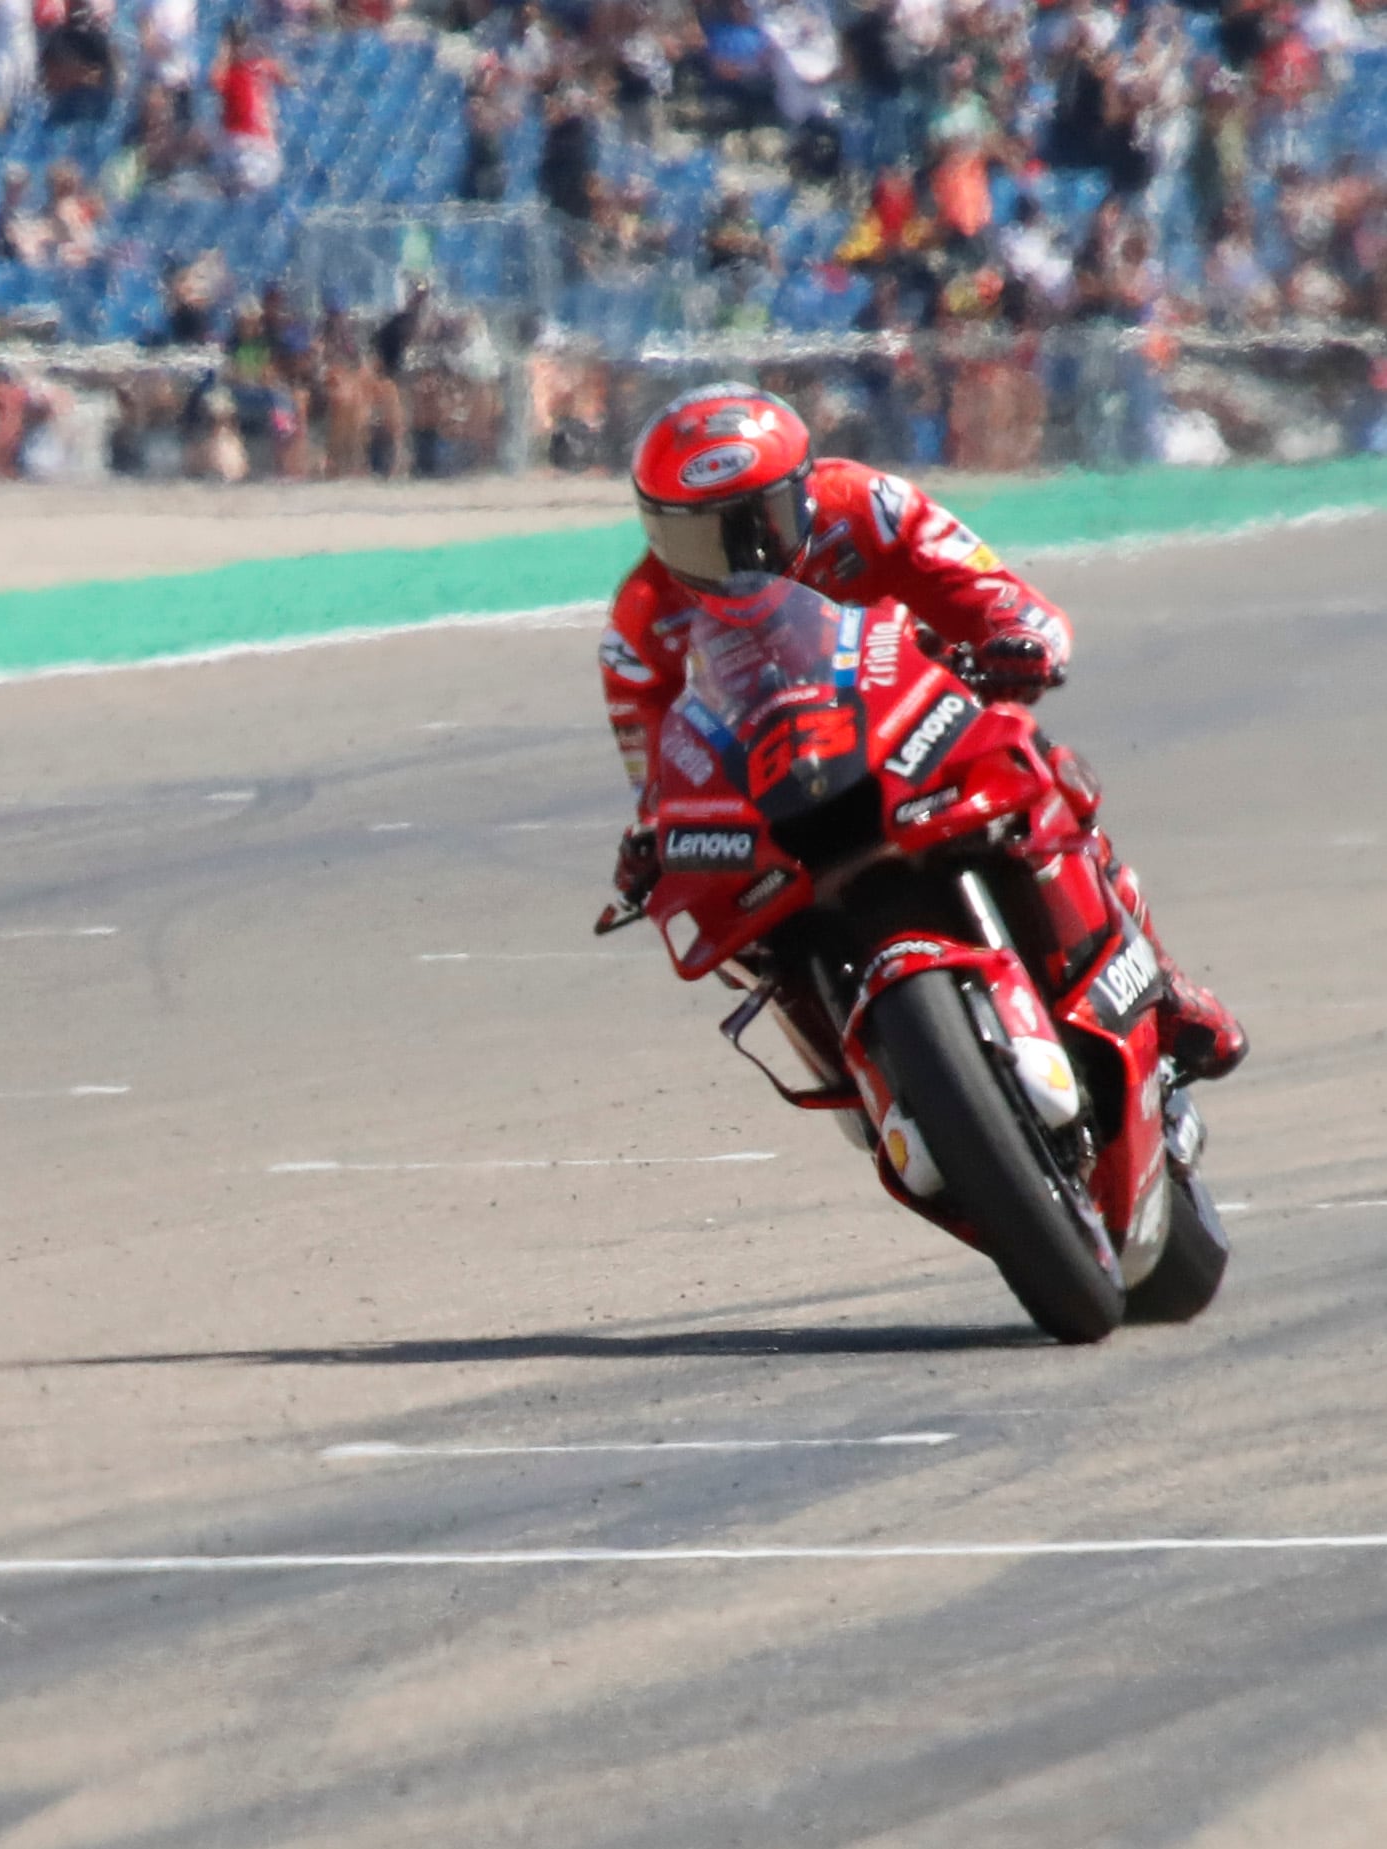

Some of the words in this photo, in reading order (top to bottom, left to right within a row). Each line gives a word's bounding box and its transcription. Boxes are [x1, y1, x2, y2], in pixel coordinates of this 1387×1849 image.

[748, 706, 857, 801] 63
[884, 694, 964, 777] Lenovo
[667, 829, 753, 860] Lenovo
